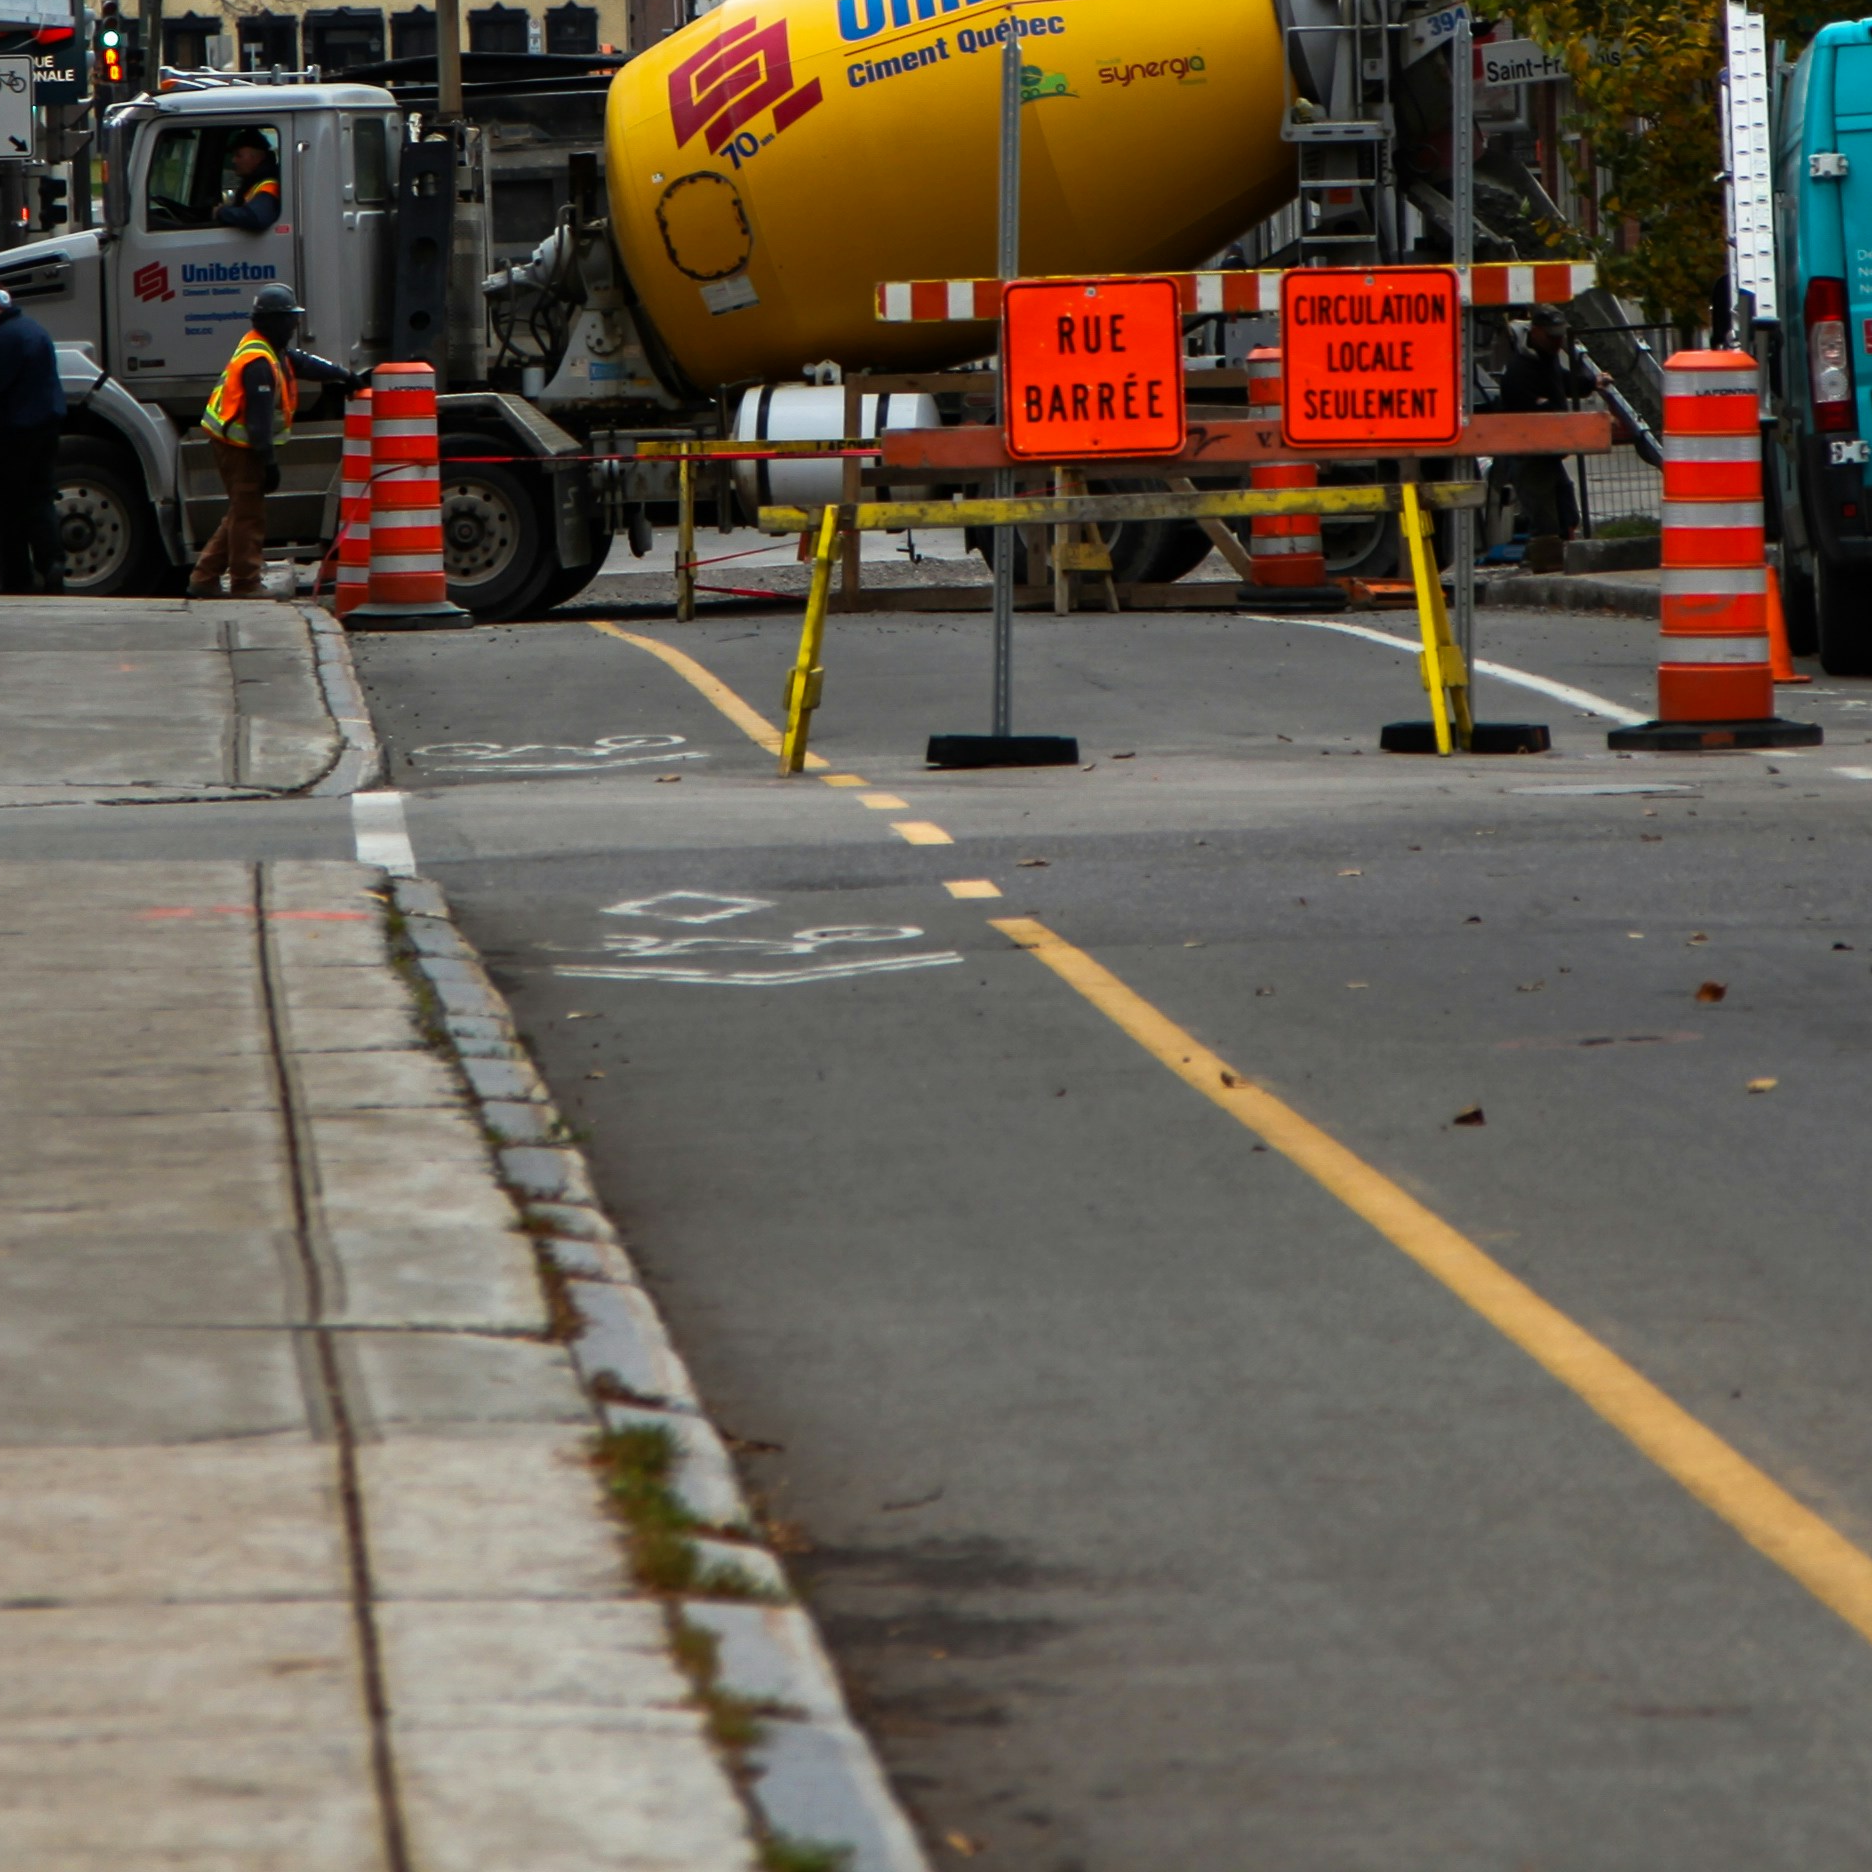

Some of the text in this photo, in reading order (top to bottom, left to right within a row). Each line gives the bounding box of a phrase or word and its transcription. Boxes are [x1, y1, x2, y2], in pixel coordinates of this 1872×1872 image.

[847, 15, 1065, 88] Ciment Québec
[1098, 55, 1206, 87] synergia
[719, 131, 759, 171] 70
[182, 261, 276, 283] Unibéton
[1294, 292, 1447, 327] CIRCULATION
[1057, 313, 1127, 355] RUE
[1327, 340, 1415, 374] LOCALE
[1026, 373, 1164, 423] BARRÉE
[1303, 386, 1438, 421] SEULEMENT
